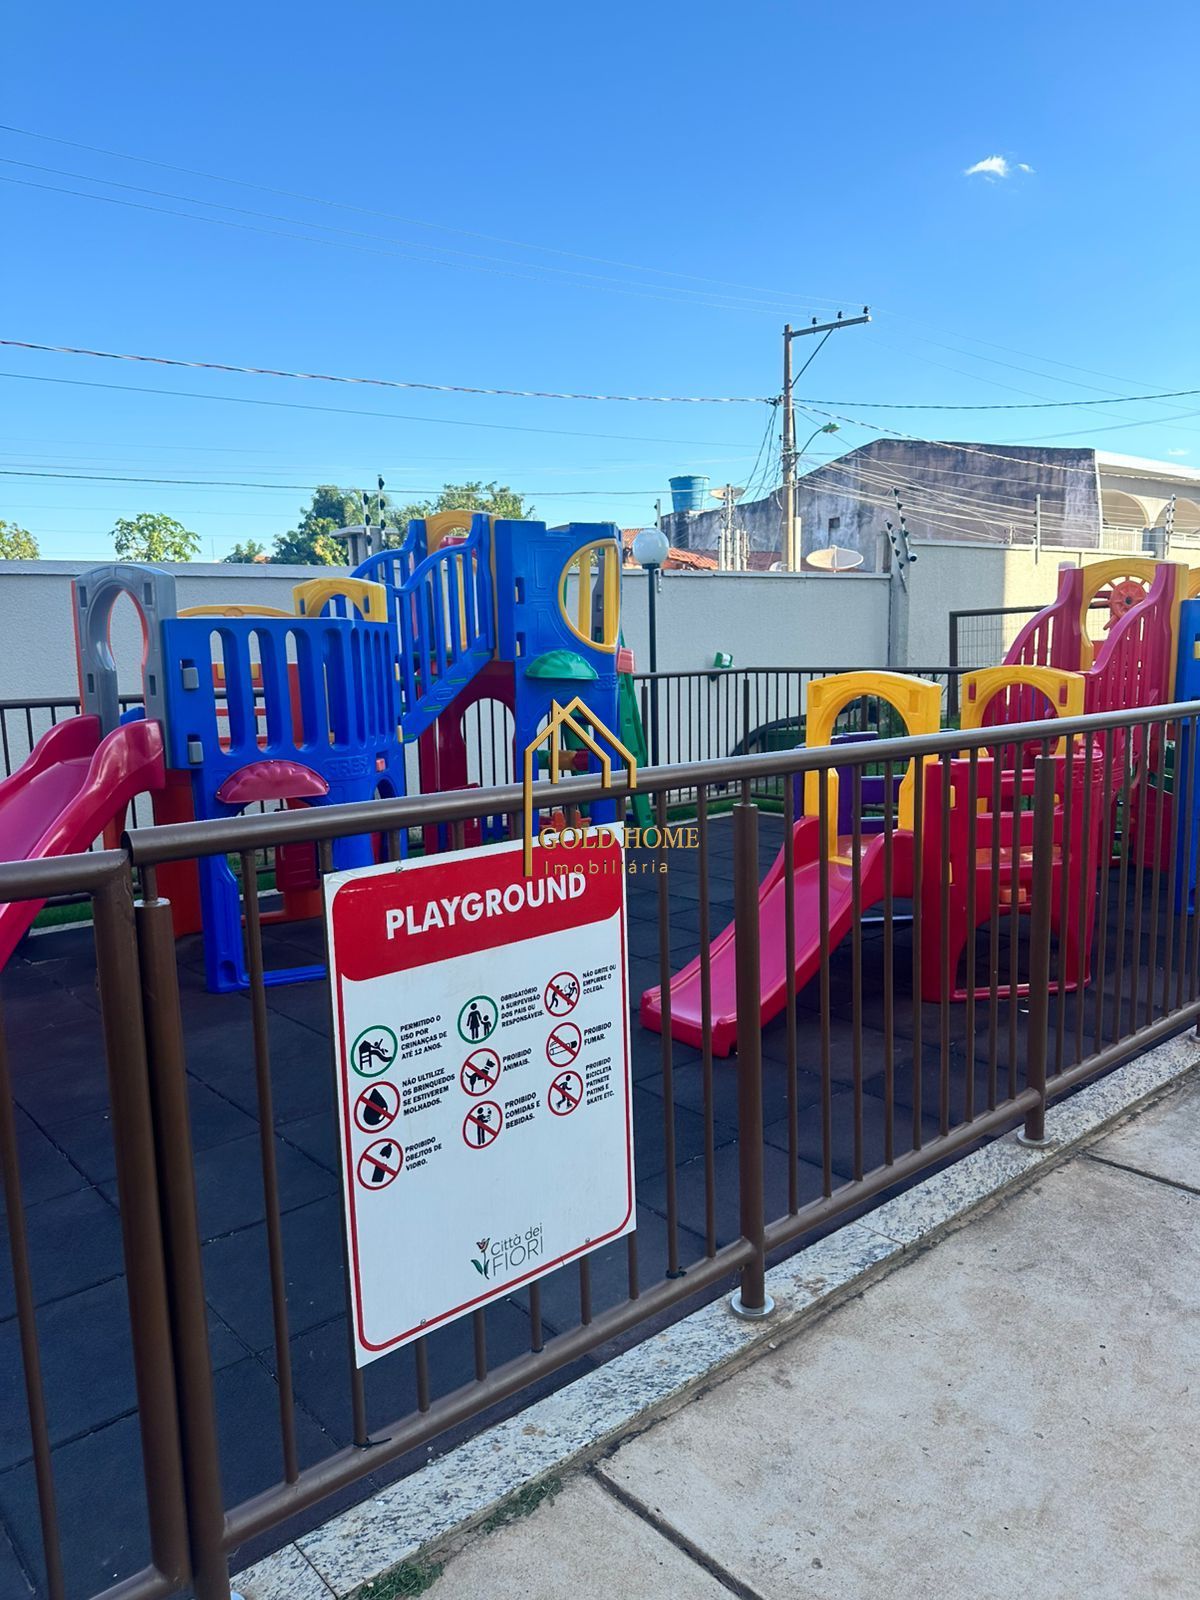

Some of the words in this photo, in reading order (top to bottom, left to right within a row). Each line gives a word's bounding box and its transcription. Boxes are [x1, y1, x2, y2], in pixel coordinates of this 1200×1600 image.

[386, 872, 586, 940] PLAYGROUND
[582, 970, 593, 978] NÃO
[594, 966, 608, 975] GRITE
[583, 975, 607, 986] EMPURRE
[500, 986, 538, 1002] OBRIGATÓRIO
[583, 984, 604, 994] COLEGA.
[501, 1011, 513, 1019] DOS
[514, 1007, 527, 1015] PAIS
[502, 1010, 544, 1027] RESPONSÁVEIS.
[400, 1017, 435, 1032] PERMITIDO
[584, 1022, 612, 1036] PROIBIDO
[400, 1032, 414, 1041] USO
[415, 1028, 429, 1037] POR
[401, 1034, 437, 1050] CRINANÇAS
[438, 1031, 447, 1039] DE
[584, 1034, 605, 1045] FUMAR.
[402, 1050, 413, 1060] ATÉ
[414, 1048, 422, 1056] 12
[424, 1042, 442, 1053] ANOS.
[503, 1048, 532, 1063] PROIBIDO
[503, 1058, 530, 1072] ANIMAIS.
[586, 1057, 611, 1071] PROIBIDO
[586, 1065, 612, 1079] BICICLETA
[402, 1077, 416, 1087] NÃO
[402, 1089, 412, 1097] OS
[413, 1073, 455, 1093] BRINQUEDOS
[586, 1074, 610, 1088] PATINETE
[403, 1098, 412, 1106] SE
[413, 1085, 449, 1103] ESTIVEREM
[586, 1085, 604, 1096] PATINS
[587, 1094, 603, 1105] SKATE
[604, 1090, 614, 1099] ETC.
[403, 1097, 442, 1116] MOLHADOS.
[504, 1092, 537, 1109] PROIBIDO
[505, 1103, 535, 1119] COMIDAS
[536, 1100, 541, 1108] E
[506, 1113, 535, 1129] BEBIDAS.
[405, 1136, 436, 1153] PROIBIDO
[434, 1143, 442, 1151] DE
[406, 1159, 428, 1171] VIDRO.
[491, 1234, 521, 1255] Città
[525, 1222, 543, 1239] dei
[492, 1236, 543, 1276] FIORI
